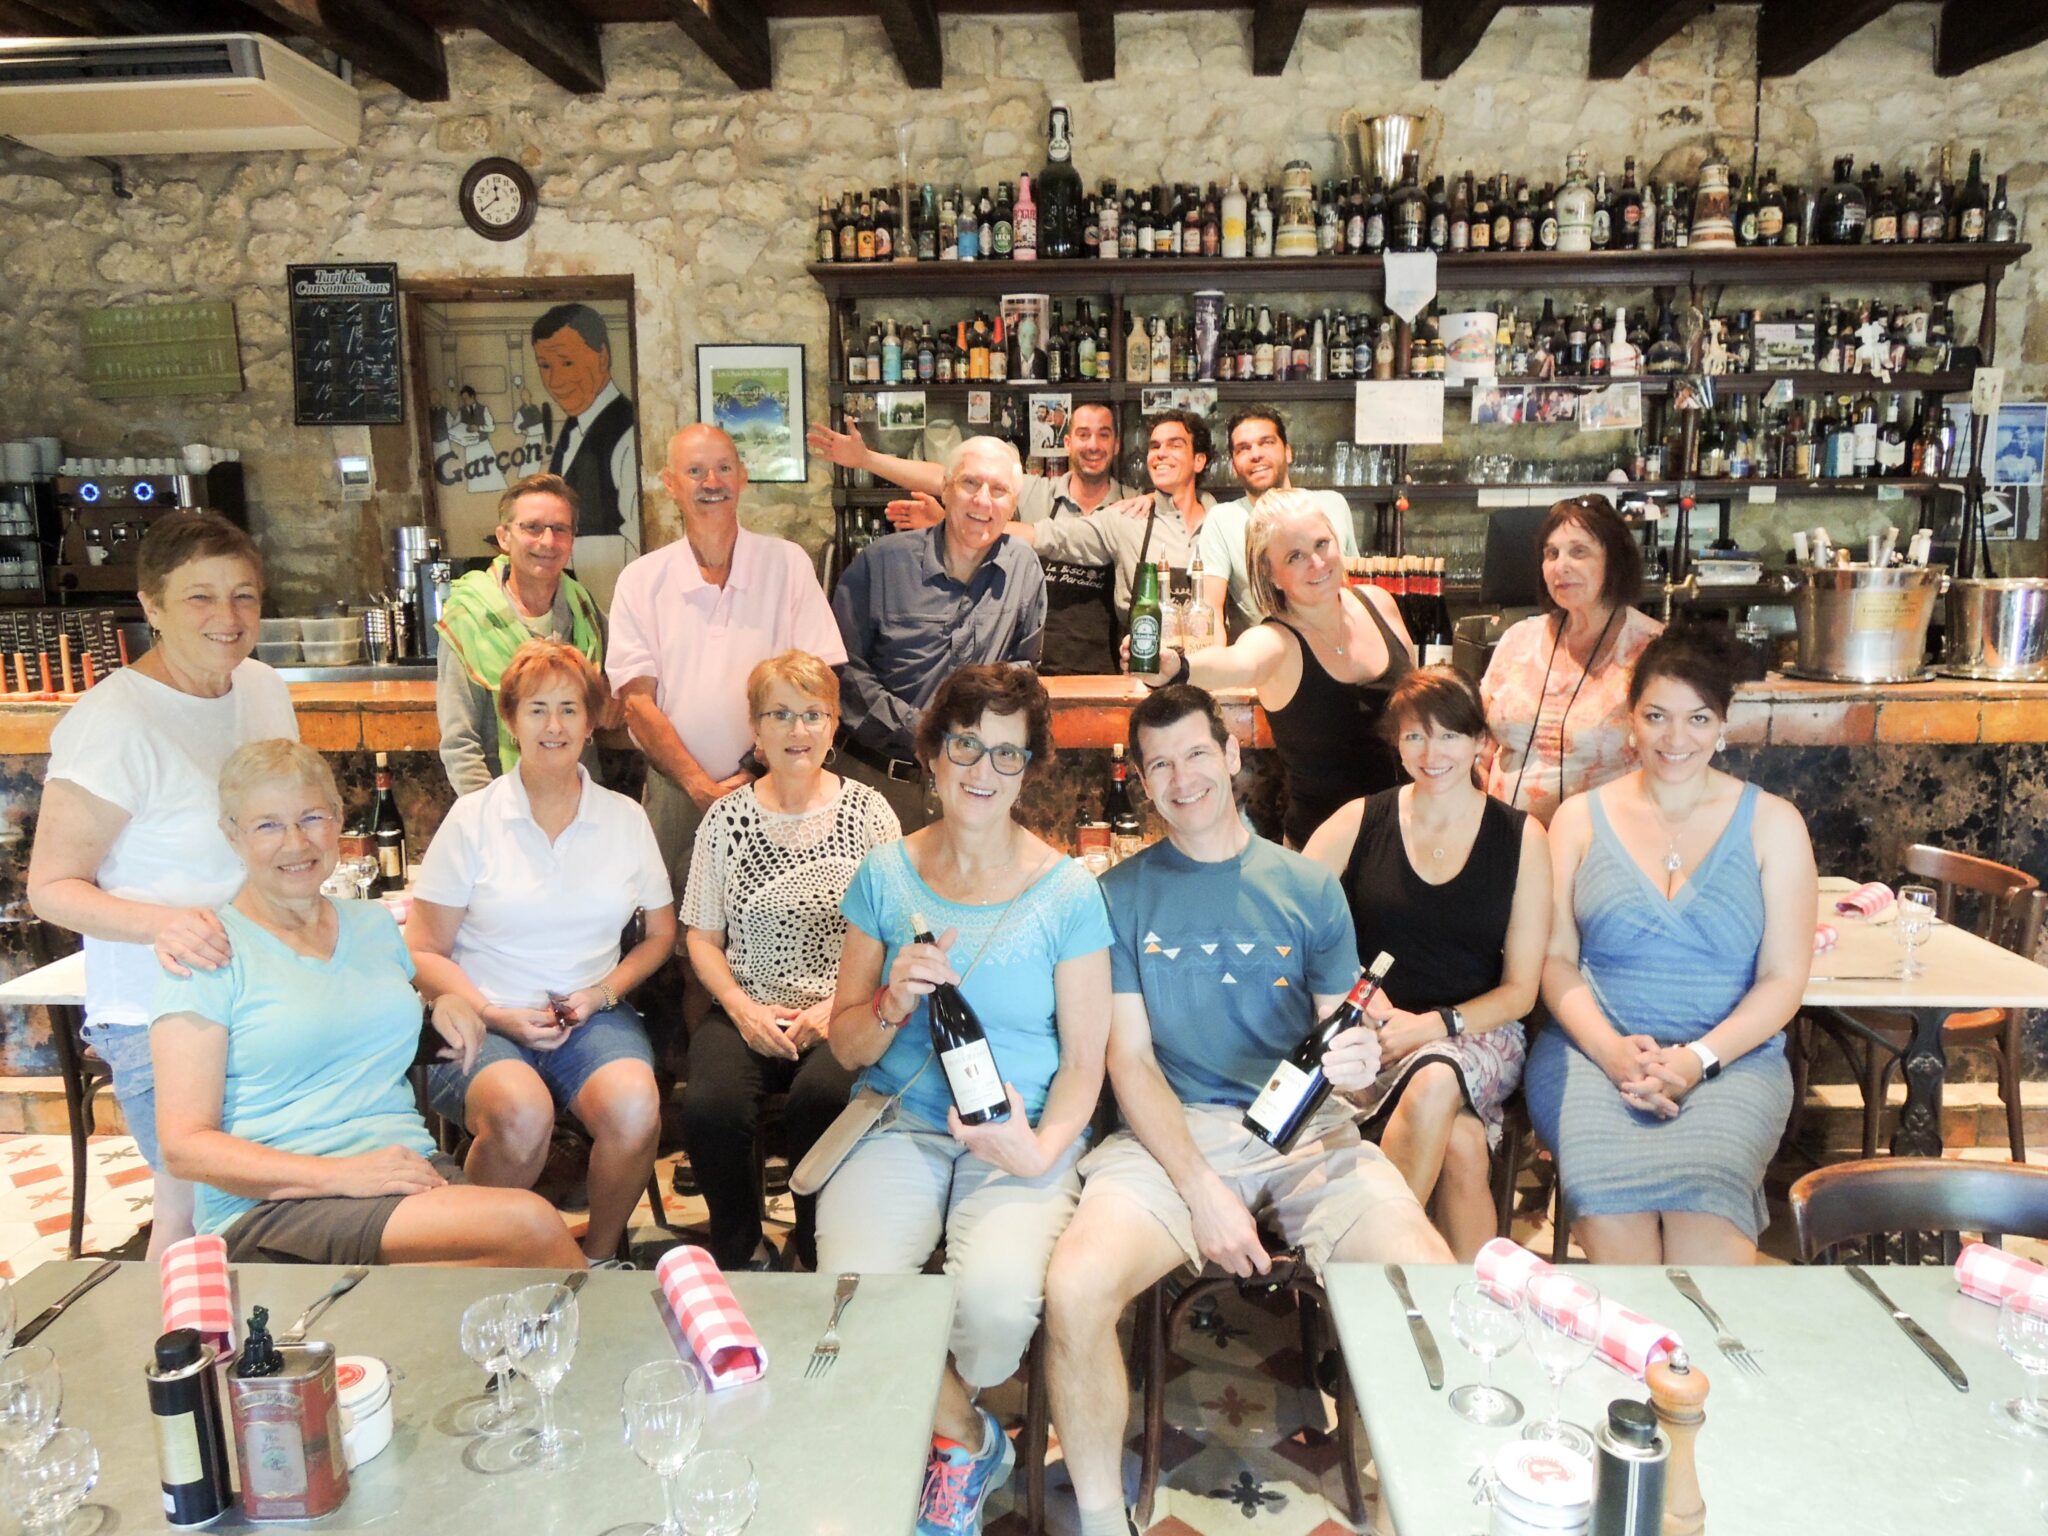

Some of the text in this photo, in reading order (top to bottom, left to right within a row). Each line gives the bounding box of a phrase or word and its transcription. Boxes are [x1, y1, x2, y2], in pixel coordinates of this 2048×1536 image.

[315, 269, 367, 284] Tarif des
[296, 281, 390, 296] Consommations
